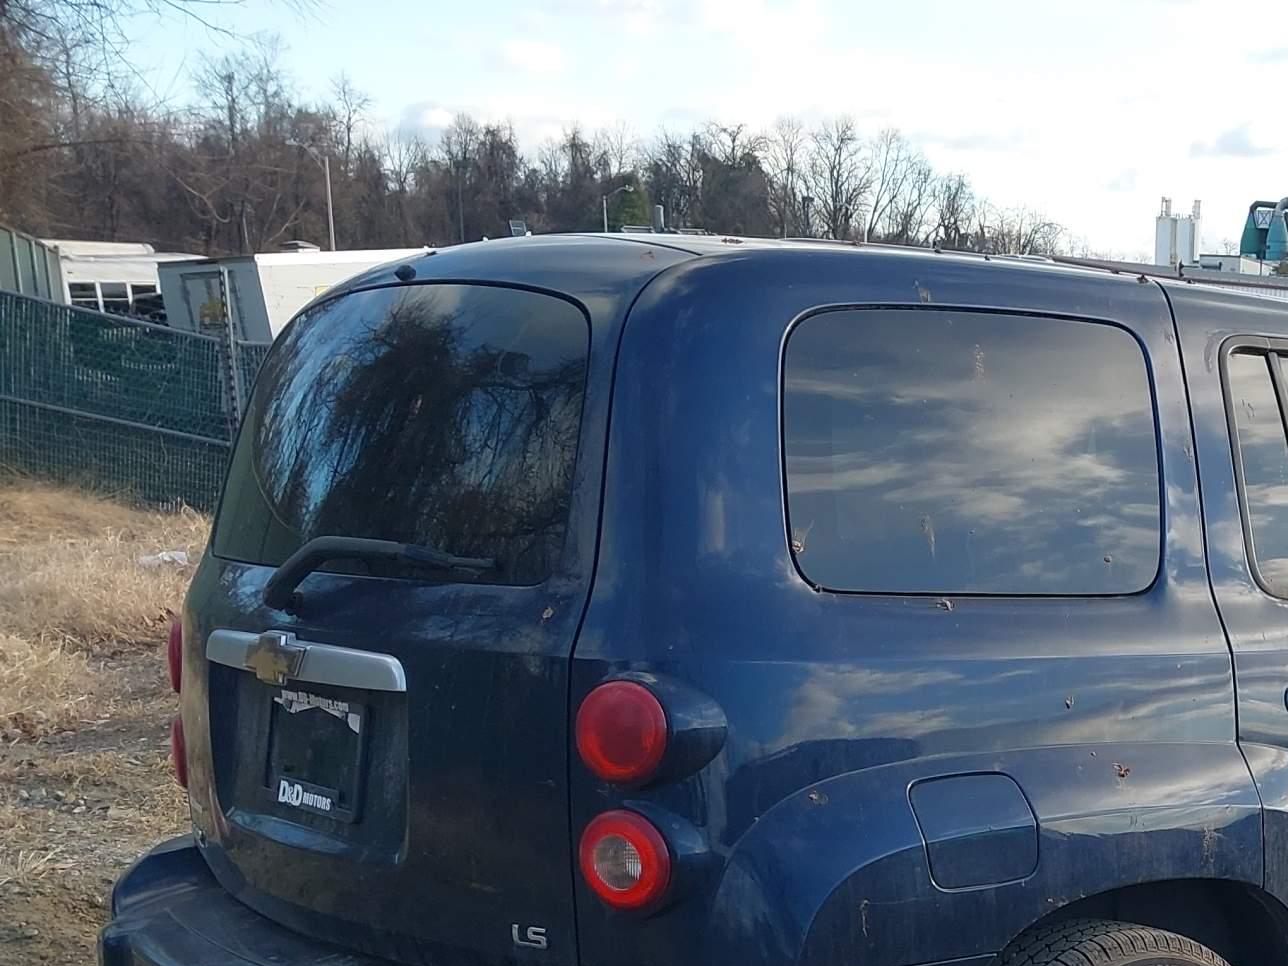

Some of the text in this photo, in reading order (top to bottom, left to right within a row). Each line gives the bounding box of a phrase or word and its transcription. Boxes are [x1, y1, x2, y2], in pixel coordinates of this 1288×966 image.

[277, 779, 332, 811] D&D MOTORS
[511, 923, 548, 950] LS
